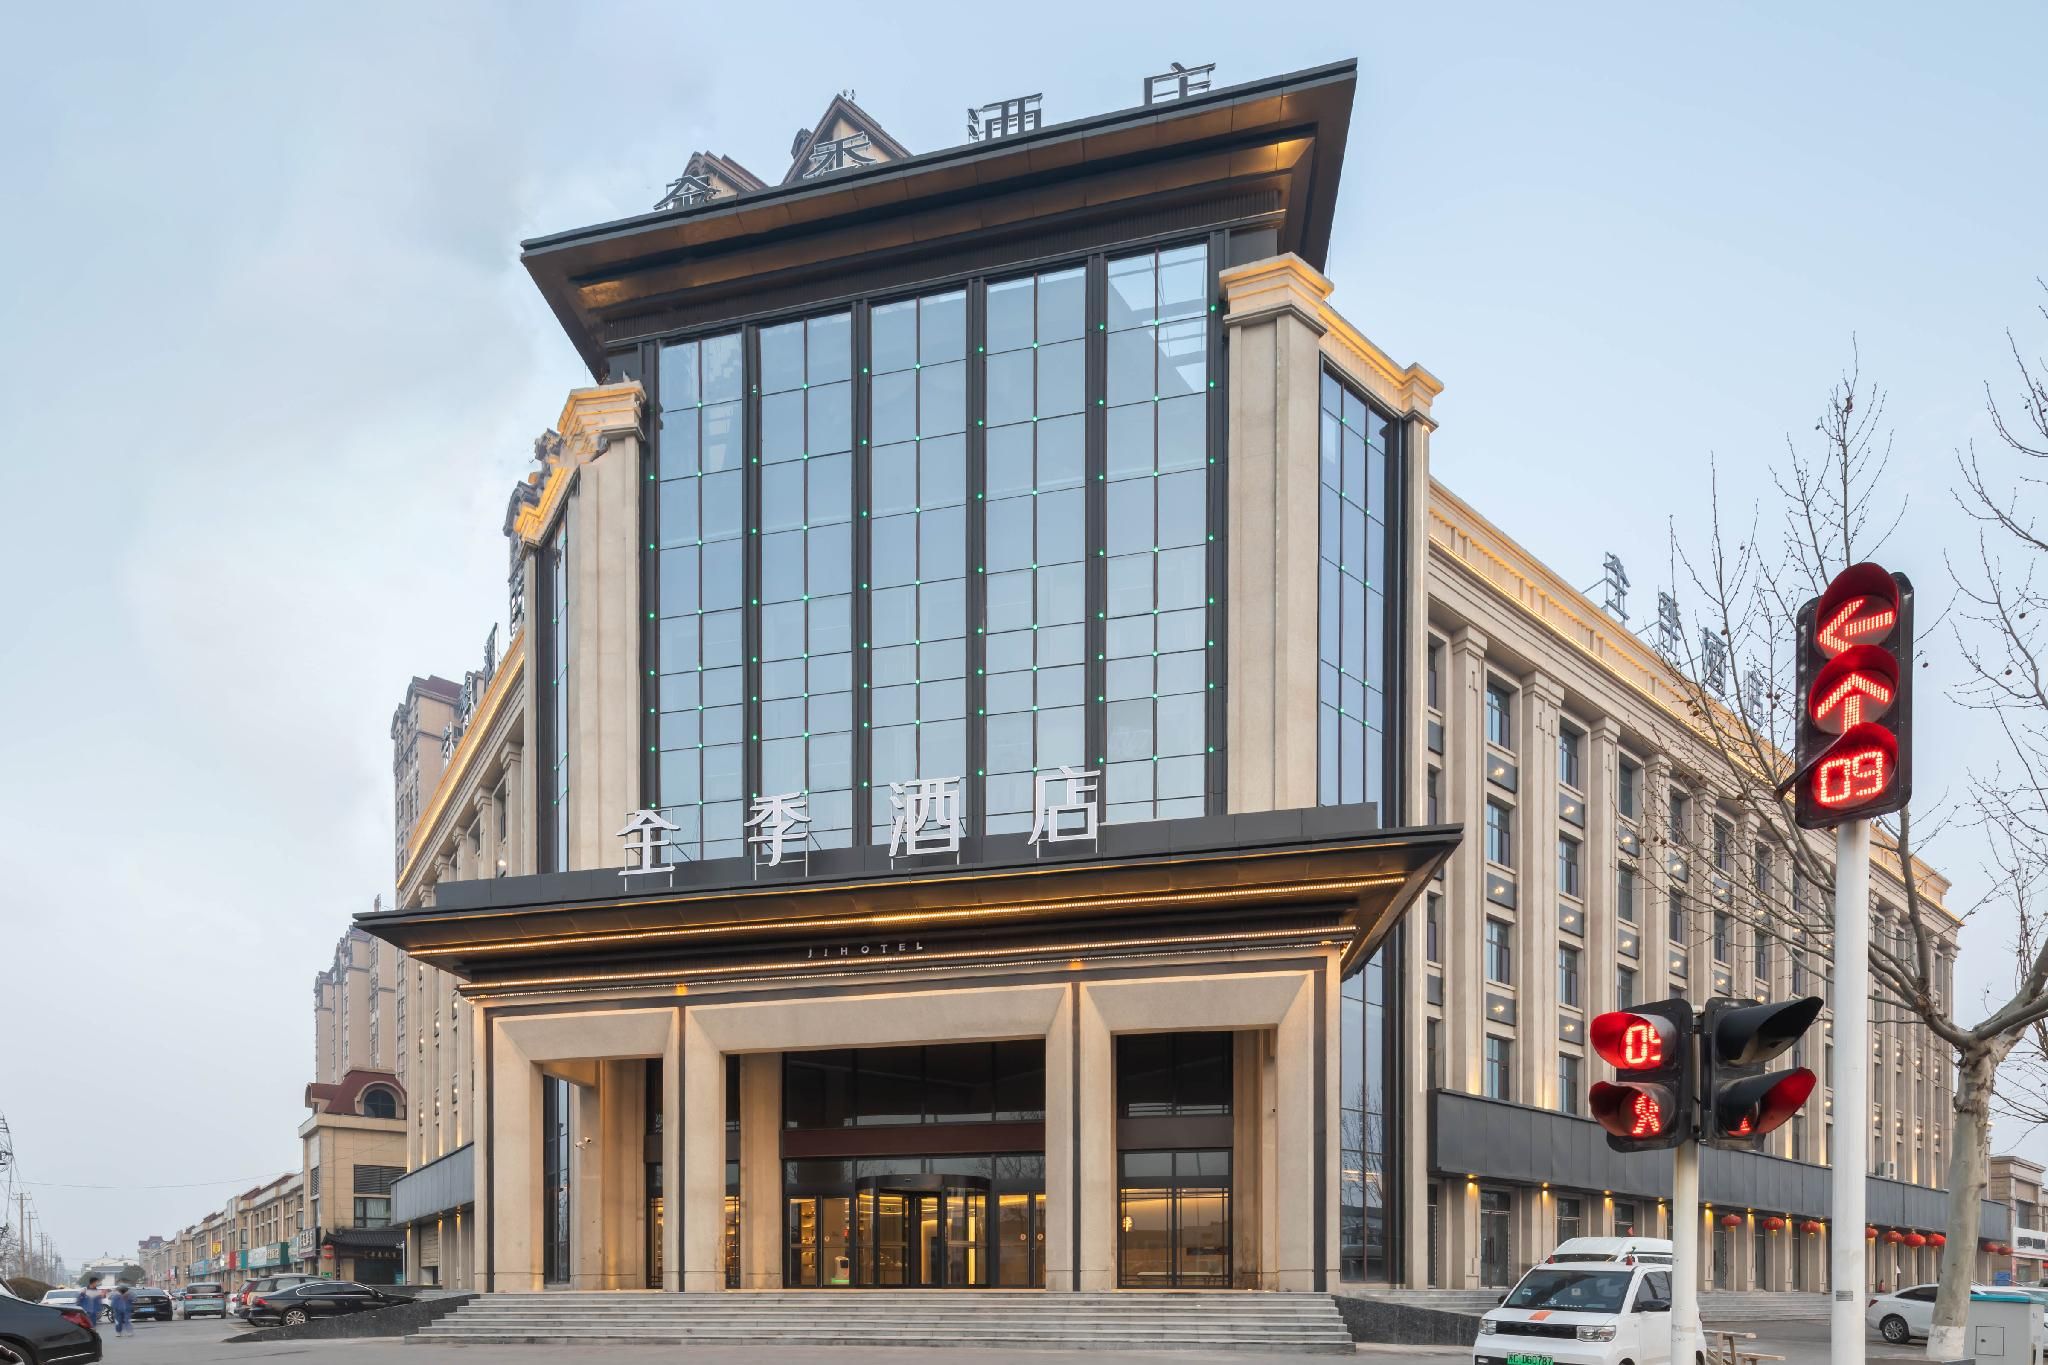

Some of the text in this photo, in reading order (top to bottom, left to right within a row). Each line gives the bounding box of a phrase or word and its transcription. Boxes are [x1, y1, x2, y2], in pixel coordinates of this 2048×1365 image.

[1821, 752, 1882, 802] 09
[616, 766, 1101, 876] 全季酒店
